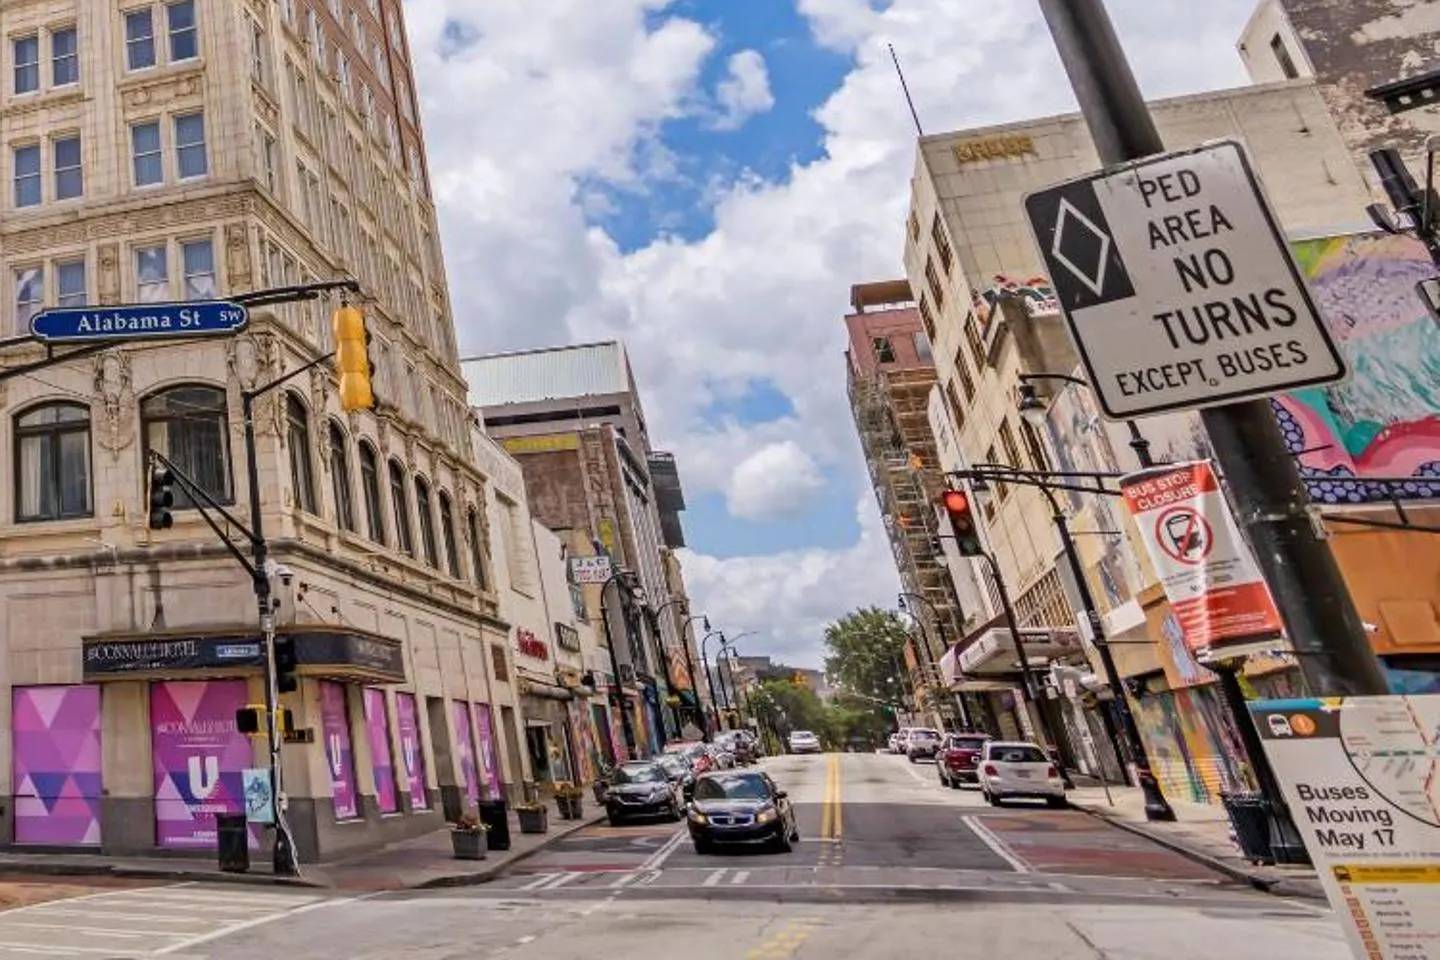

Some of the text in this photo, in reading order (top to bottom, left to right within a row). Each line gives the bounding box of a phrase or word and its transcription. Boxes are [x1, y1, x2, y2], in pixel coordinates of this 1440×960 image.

[1137, 170, 1202, 208] PED
[1147, 204, 1235, 250] AREA
[1173, 248, 1235, 293] NO
[77, 309, 241, 332] Alabama St SW
[1153, 288, 1298, 349] TURNS
[1115, 341, 1308, 396] EXCEPT BUSES
[1127, 471, 1192, 500] BUS STOP
[1137, 483, 1200, 510] CLOSURE
[188, 756, 219, 799] U
[1295, 783, 1371, 801] Buses
[1306, 805, 1393, 826] Moving
[1315, 828, 1396, 849] May 17
